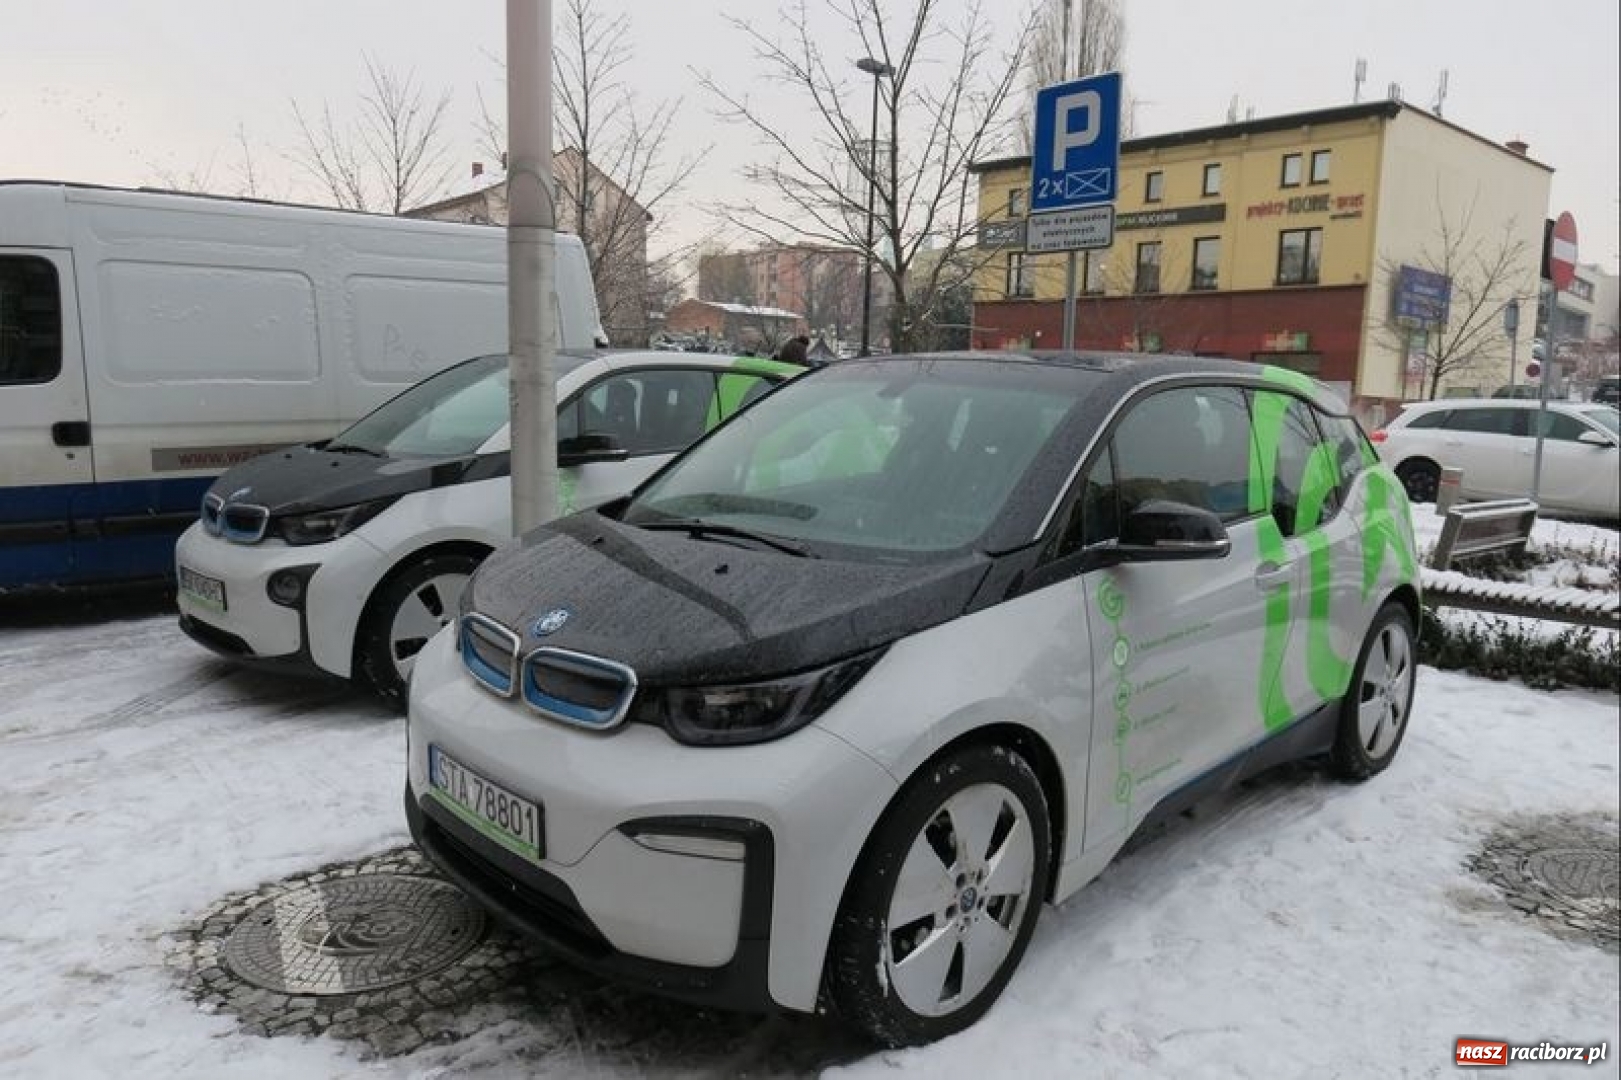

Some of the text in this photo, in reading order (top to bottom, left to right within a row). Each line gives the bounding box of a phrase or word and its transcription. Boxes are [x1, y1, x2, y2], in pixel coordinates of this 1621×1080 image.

[1053, 91, 1100, 171] P
[440, 757, 534, 844] STA 78801
